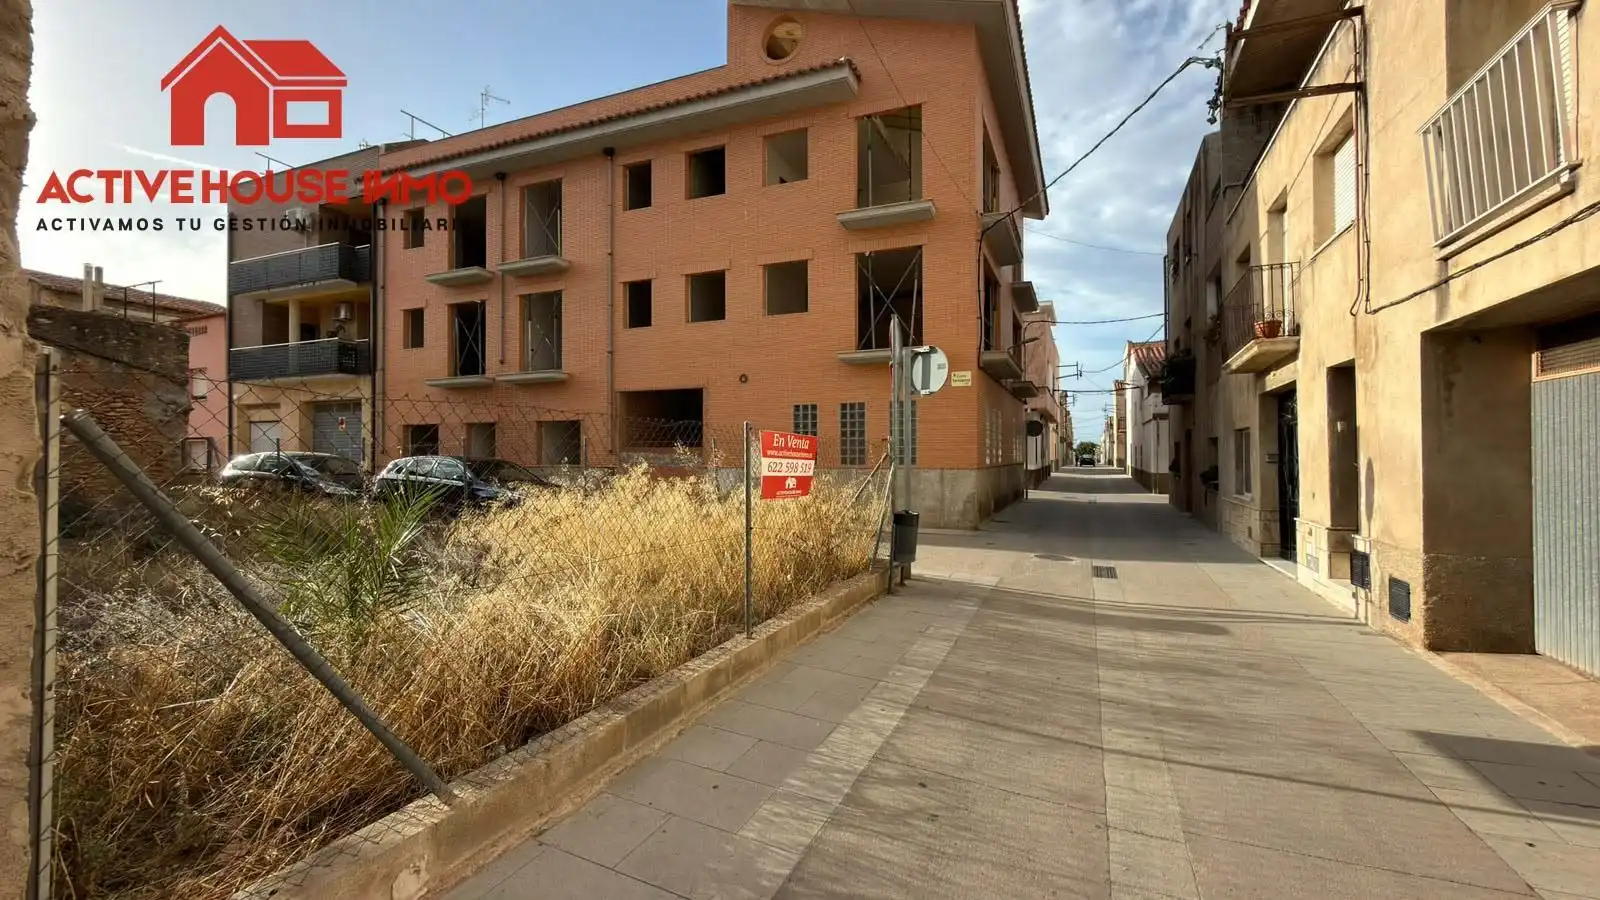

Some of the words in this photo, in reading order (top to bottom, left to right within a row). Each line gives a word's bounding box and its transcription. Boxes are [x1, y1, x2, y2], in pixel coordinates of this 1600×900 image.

[774, 433, 785, 447] En
[788, 435, 809, 449] Venta
[768, 461, 783, 473] 622
[785, 462, 799, 474] 598
